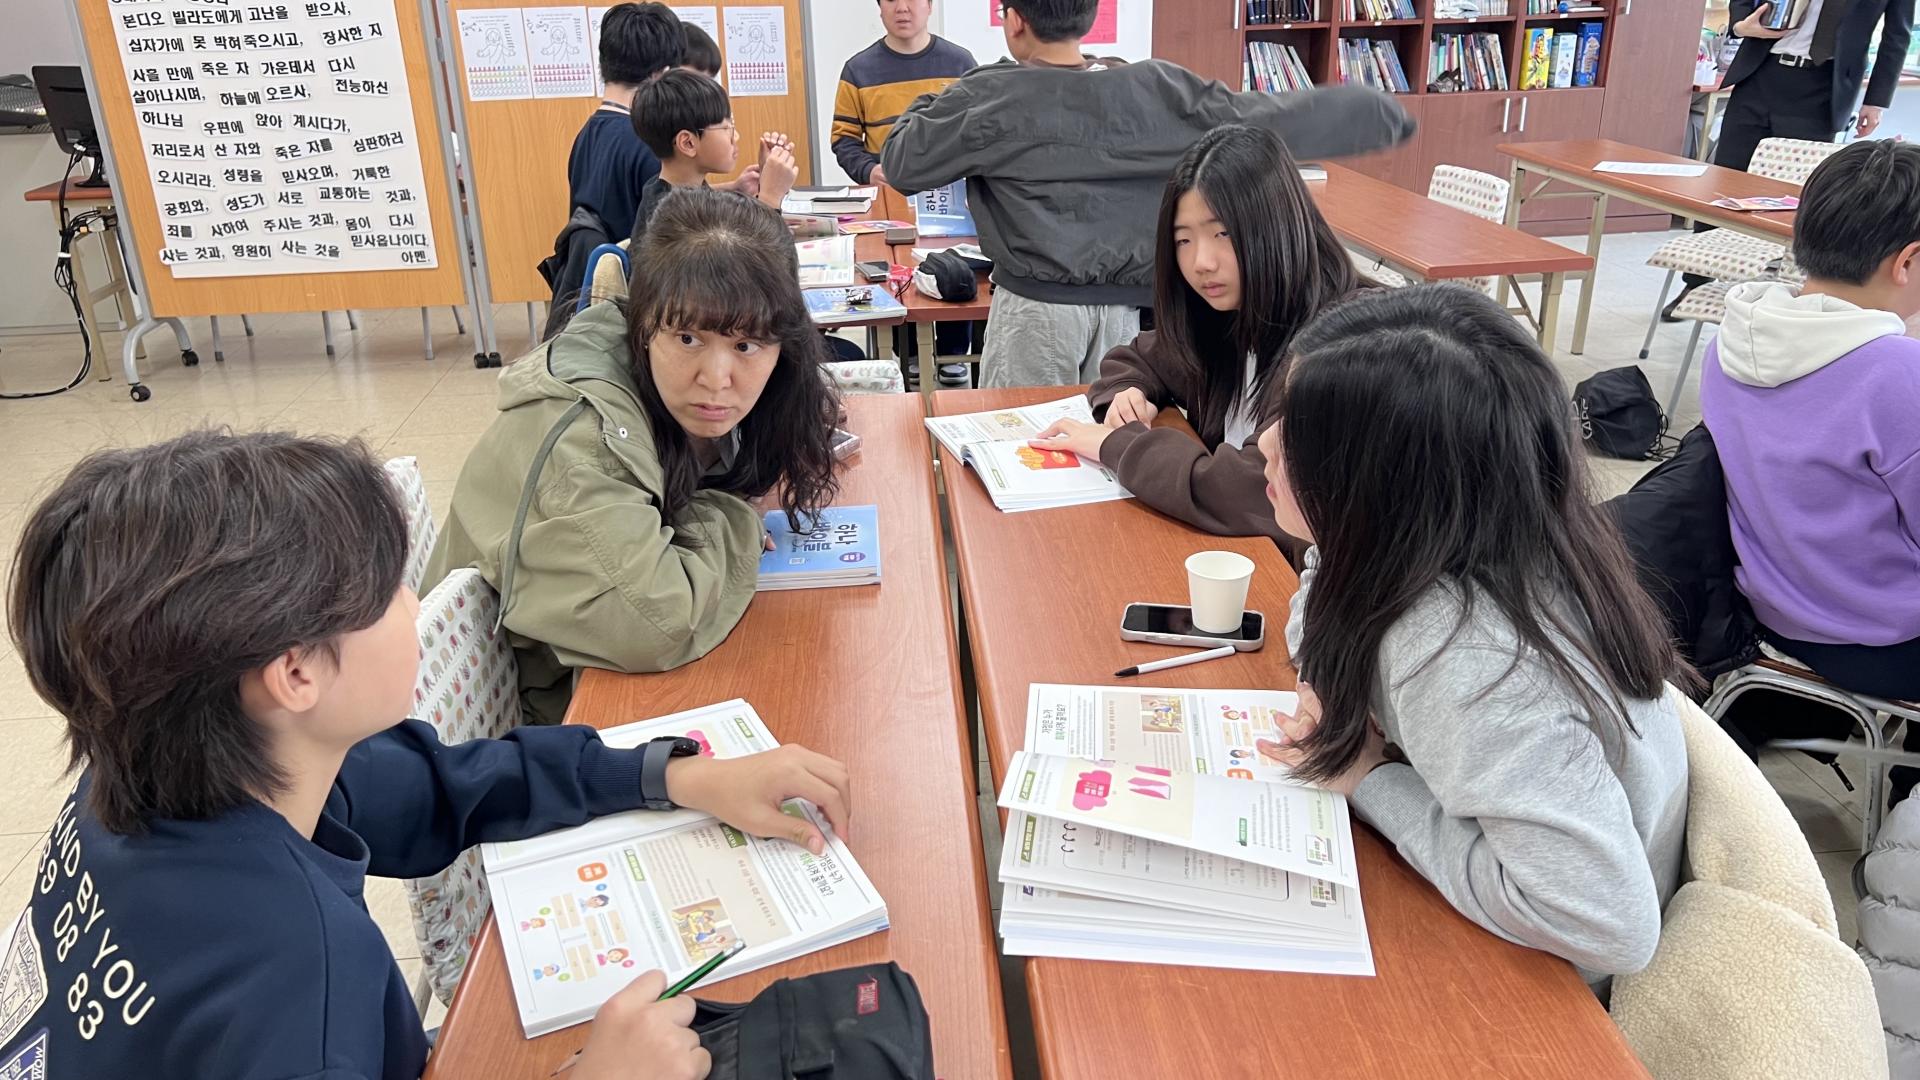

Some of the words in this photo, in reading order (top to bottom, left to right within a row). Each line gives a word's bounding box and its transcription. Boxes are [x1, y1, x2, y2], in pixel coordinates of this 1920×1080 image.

[122, 11, 165, 29] 본디오
[172, 9, 243, 25] 빌라도에게
[247, 5, 289, 21] 고난을
[305, 1, 351, 17] 받으사,
[128, 37, 185, 53] 십자가에
[193, 35, 206, 50] 못
[213, 35, 242, 51] 박혀
[243, 32, 303, 48] 죽으시고,
[322, 25, 363, 46] 장사한
[368, 22, 382, 37] 지
[166, 66, 194, 81] 만에
[201, 61, 229, 76] 죽은
[234, 61, 250, 75] 자
[260, 59, 316, 76] 가운데서
[328, 56, 356, 73] 다시
[132, 86, 206, 104] 살아나시며,
[219, 91, 262, 106] 하늘에
[266, 84, 311, 101] 오르사,
[335, 78, 389, 95] 전능하신
[142, 111, 184, 128] 하나님
[203, 120, 245, 136] 우편에
[255, 113, 283, 129] 앉아
[292, 114, 351, 134] 계시다가,
[151, 143, 206, 158] 저리로서
[214, 143, 228, 157] 산
[233, 141, 261, 156] 자와
[274, 143, 302, 160] 죽은
[306, 137, 333, 154] 자를
[353, 131, 404, 153] 심판하러
[157, 170, 216, 188] 오시리라.
[223, 168, 263, 183] 성령을
[282, 164, 339, 184] 믿사오며,
[352, 165, 391, 181] 거룩한
[164, 199, 209, 217] 공회와,
[226, 192, 265, 212] 성도가
[278, 191, 304, 205] 서로
[319, 186, 371, 200] 교통하는
[385, 188, 416, 204] 것과,
[167, 224, 193, 239] 죄를
[211, 218, 250, 238] 사하여
[263, 217, 302, 232] 주시는
[308, 212, 339, 227] 것과,
[345, 216, 372, 232] 몸이
[388, 213, 415, 227] 다시
[162, 248, 189, 262] 사는
[195, 246, 225, 260] 것과,
[231, 244, 272, 258] 영원히
[281, 240, 307, 255] 사는
[315, 243, 340, 258] 것을
[350, 233, 430, 248] 믿사옵나이다.
[401, 250, 431, 264] 아멘.
[803, 521, 832, 552] 바이블
[834, 523, 858, 545] 하나
[54, 801, 80, 877] AND
[77, 871, 105, 933] BY
[93, 928, 155, 1025] YOU
[53, 901, 78, 962] 08
[68, 973, 104, 1040] 83
